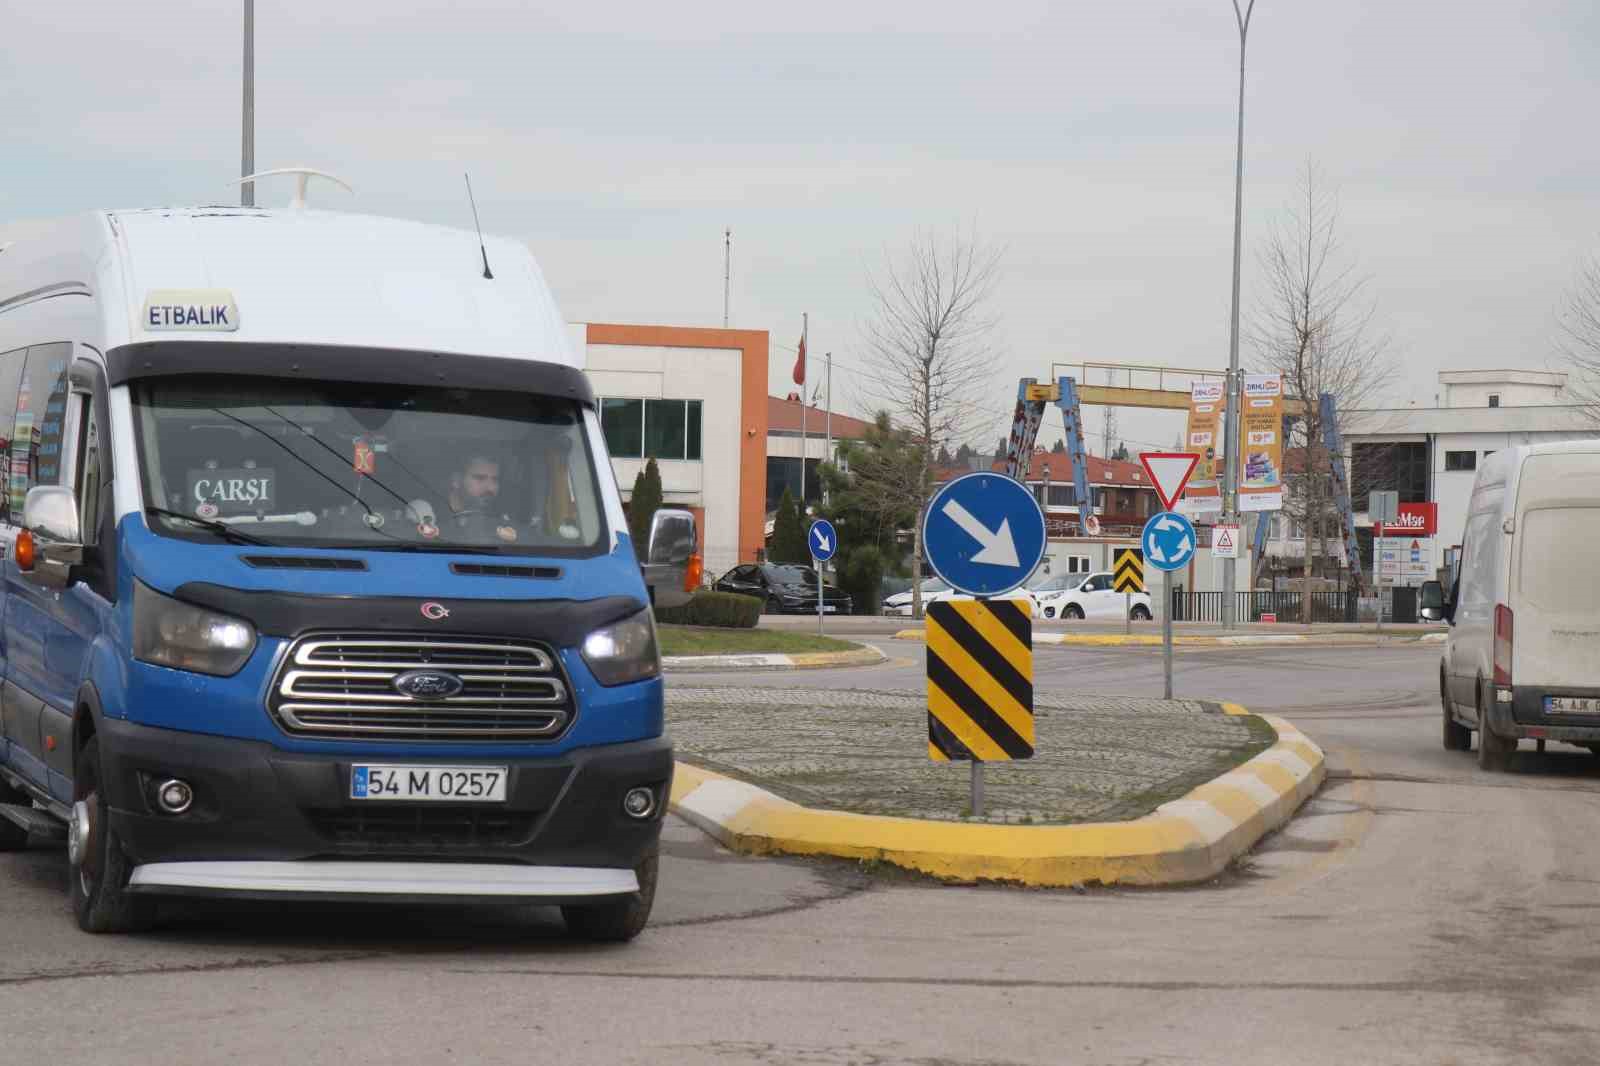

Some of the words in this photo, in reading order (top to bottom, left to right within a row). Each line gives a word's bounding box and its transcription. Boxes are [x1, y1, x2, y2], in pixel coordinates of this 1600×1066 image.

[150, 305, 228, 326] ETBALIK
[194, 477, 269, 505] ÇARŞI
[369, 771, 399, 795] 54
[409, 771, 430, 795] M
[440, 773, 499, 797] 0257
